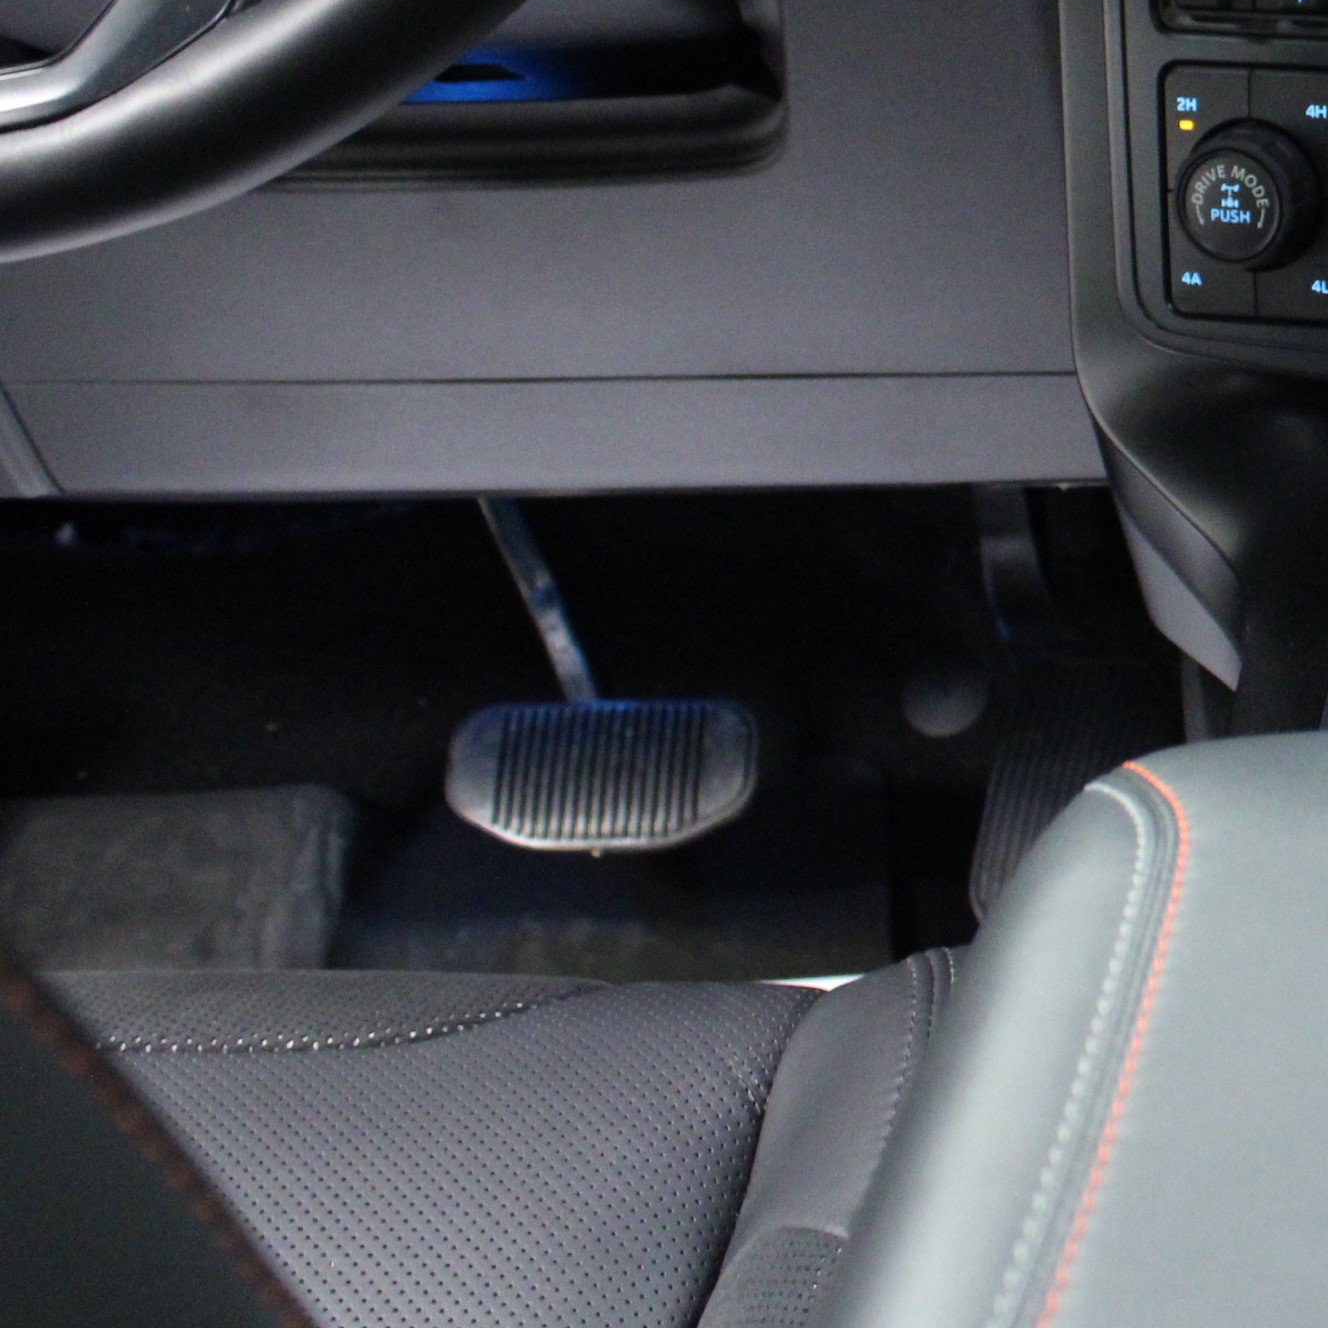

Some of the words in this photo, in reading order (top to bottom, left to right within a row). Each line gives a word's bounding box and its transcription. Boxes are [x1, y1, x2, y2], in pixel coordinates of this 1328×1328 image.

[1176, 97, 1198, 112] 2H
[1305, 104, 1328, 119] 4H
[1190, 163, 1226, 206] DRIVE
[1229, 164, 1270, 209] MODE
[1210, 208, 1251, 224] PUSH
[1181, 271, 1203, 286] 4A
